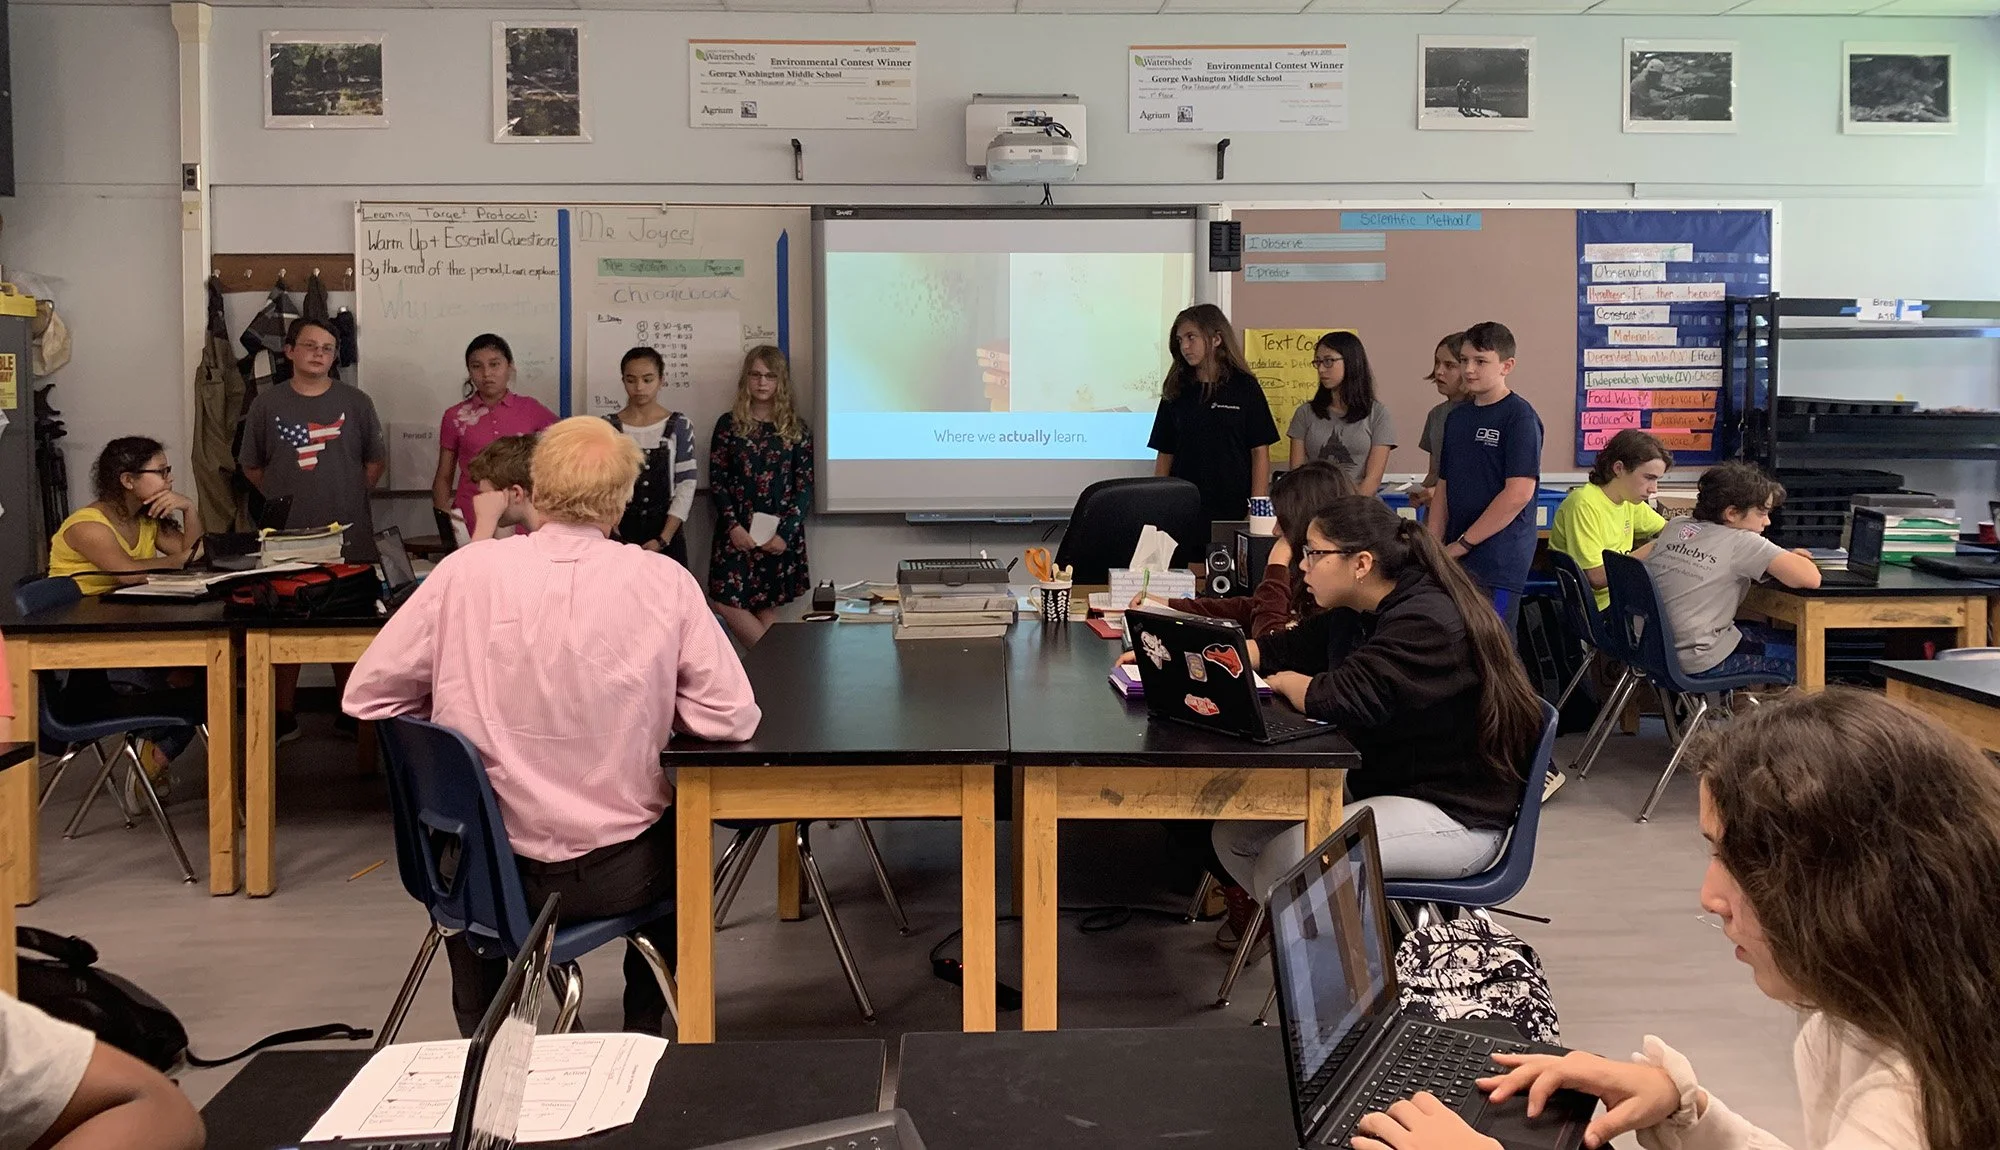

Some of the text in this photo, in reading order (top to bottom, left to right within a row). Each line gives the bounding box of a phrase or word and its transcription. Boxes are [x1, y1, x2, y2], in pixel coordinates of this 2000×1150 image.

[705, 52, 756, 62] Watersheds
[770, 57, 912, 69] Environmental Contest Winner
[1143, 57, 1193, 67] Watersheds
[1206, 61, 1344, 70] Environmental Contest Winner
[709, 70, 737, 79] George
[739, 70, 785, 80] Washington
[787, 70, 815, 79] Middle
[816, 71, 842, 79] School
[1151, 74, 1282, 84] George Washington Middle School
[701, 104, 734, 116] Agrium
[1139, 110, 1170, 120] Agrium
[1360, 212, 1416, 225] Scientific
[367, 228, 405, 252] Warm
[409, 228, 428, 262] Up
[444, 226, 499, 249] Essential
[361, 258, 380, 282] By
[382, 258, 402, 274] the
[403, 258, 425, 276] end
[428, 260, 444, 277] of
[448, 258, 468, 277] the
[1594, 263, 1655, 279] Observation
[1261, 332, 1294, 352] Text
[1585, 371, 1640, 387] Independent
[1588, 390, 1637, 404] Food Web
[403, 431, 433, 440] Period 2
[934, 428, 1087, 446] Where we actually learn.
